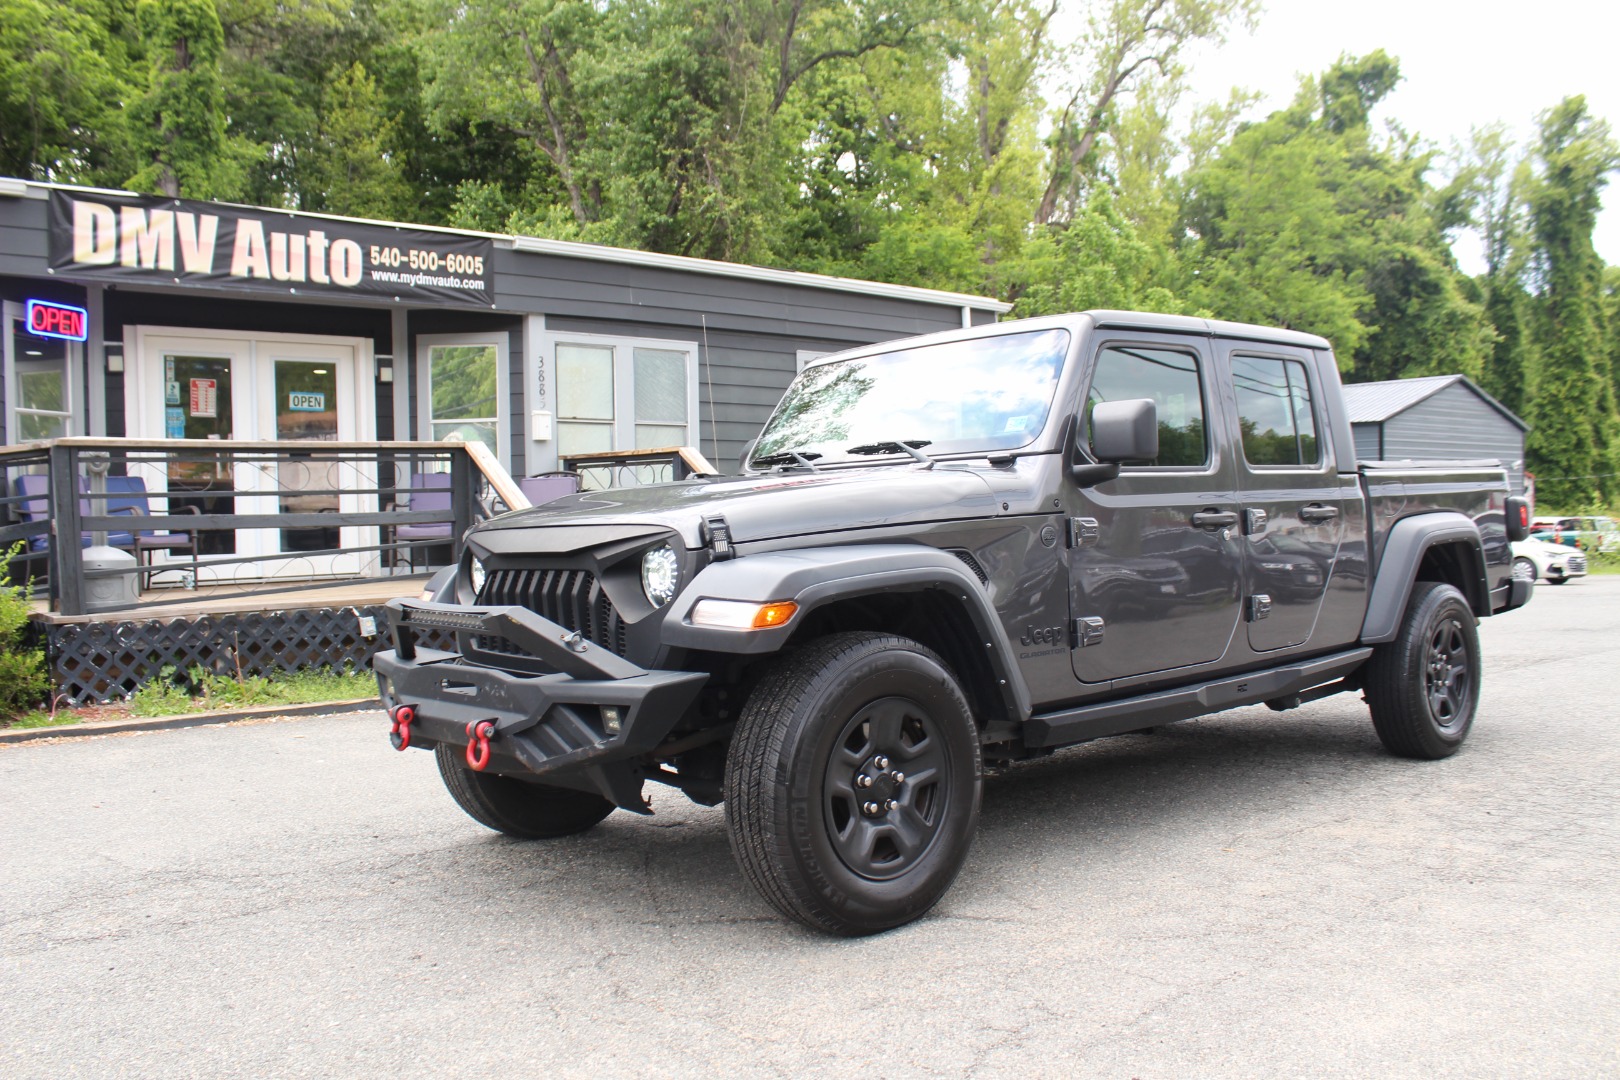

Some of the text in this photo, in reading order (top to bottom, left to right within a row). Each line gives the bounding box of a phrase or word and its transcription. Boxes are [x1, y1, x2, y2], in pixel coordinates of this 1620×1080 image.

[73, 200, 363, 286] DMV Auto
[370, 245, 484, 276] 540-500-6005
[371, 270, 485, 290] www.mydmvauto.com
[32, 305, 84, 337] OPEN
[292, 395, 322, 408] OPEN
[1020, 625, 1062, 647] Jeep
[1020, 647, 1066, 660] GLADIATOR
